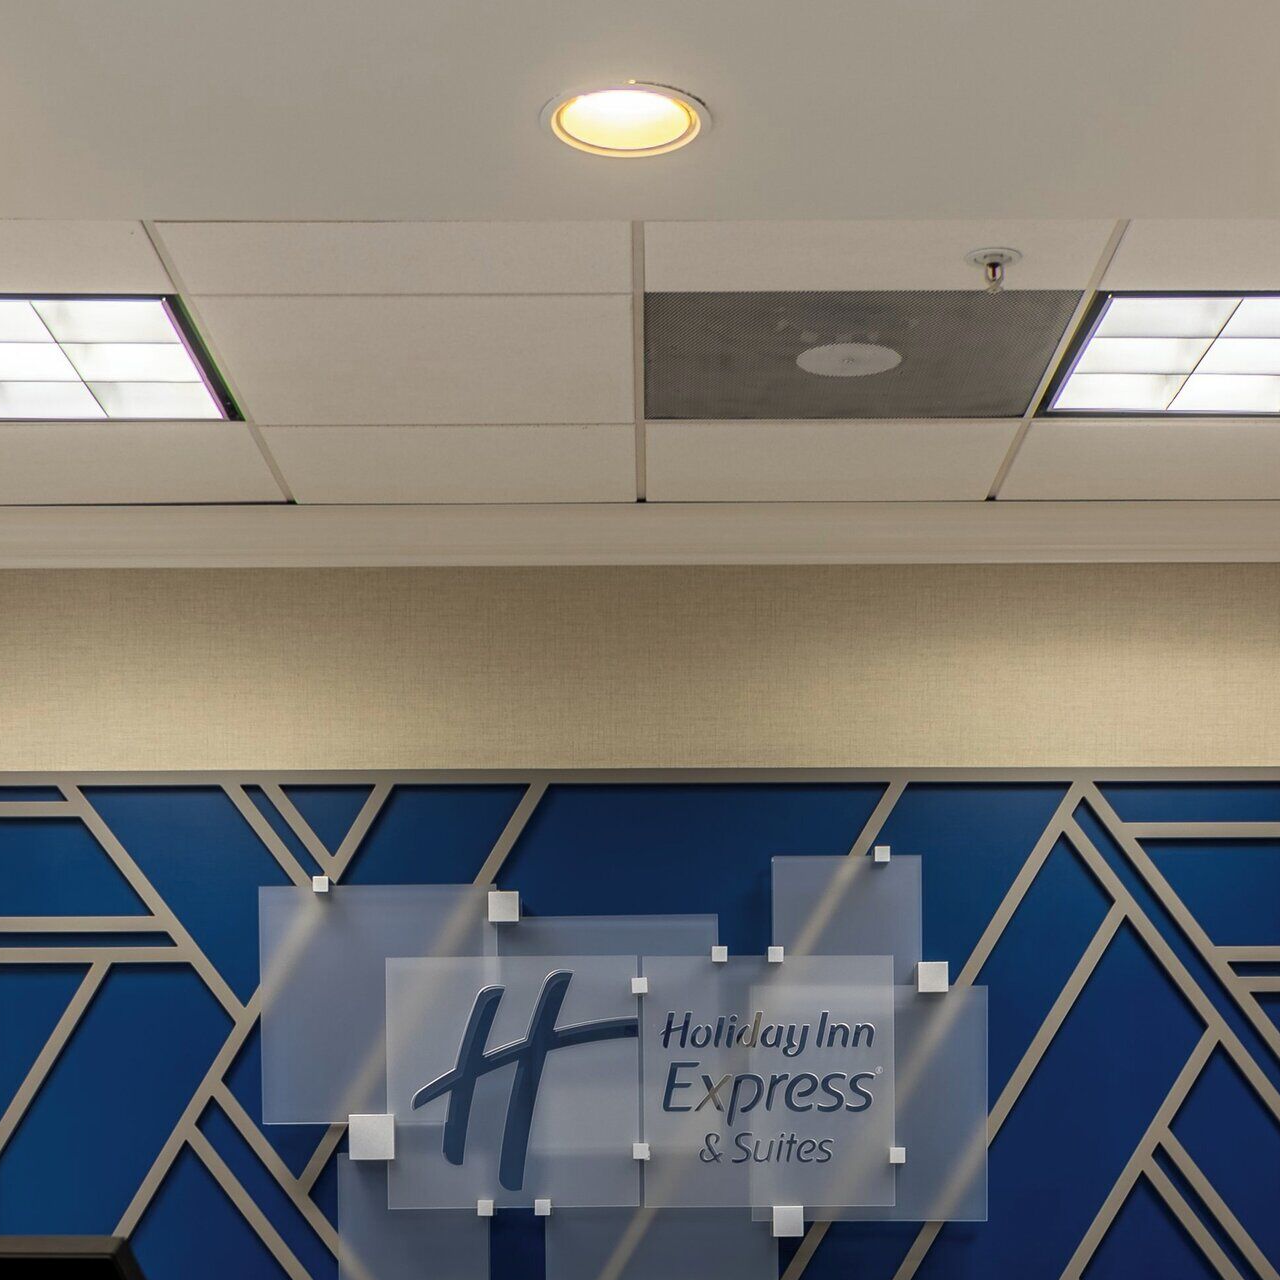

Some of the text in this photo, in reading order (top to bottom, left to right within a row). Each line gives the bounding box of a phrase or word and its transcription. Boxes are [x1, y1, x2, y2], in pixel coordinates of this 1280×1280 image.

[660, 1010, 876, 1057] Holiday Inn
[662, 1061, 876, 1127] Express
[699, 1131, 834, 1164] & Suites
